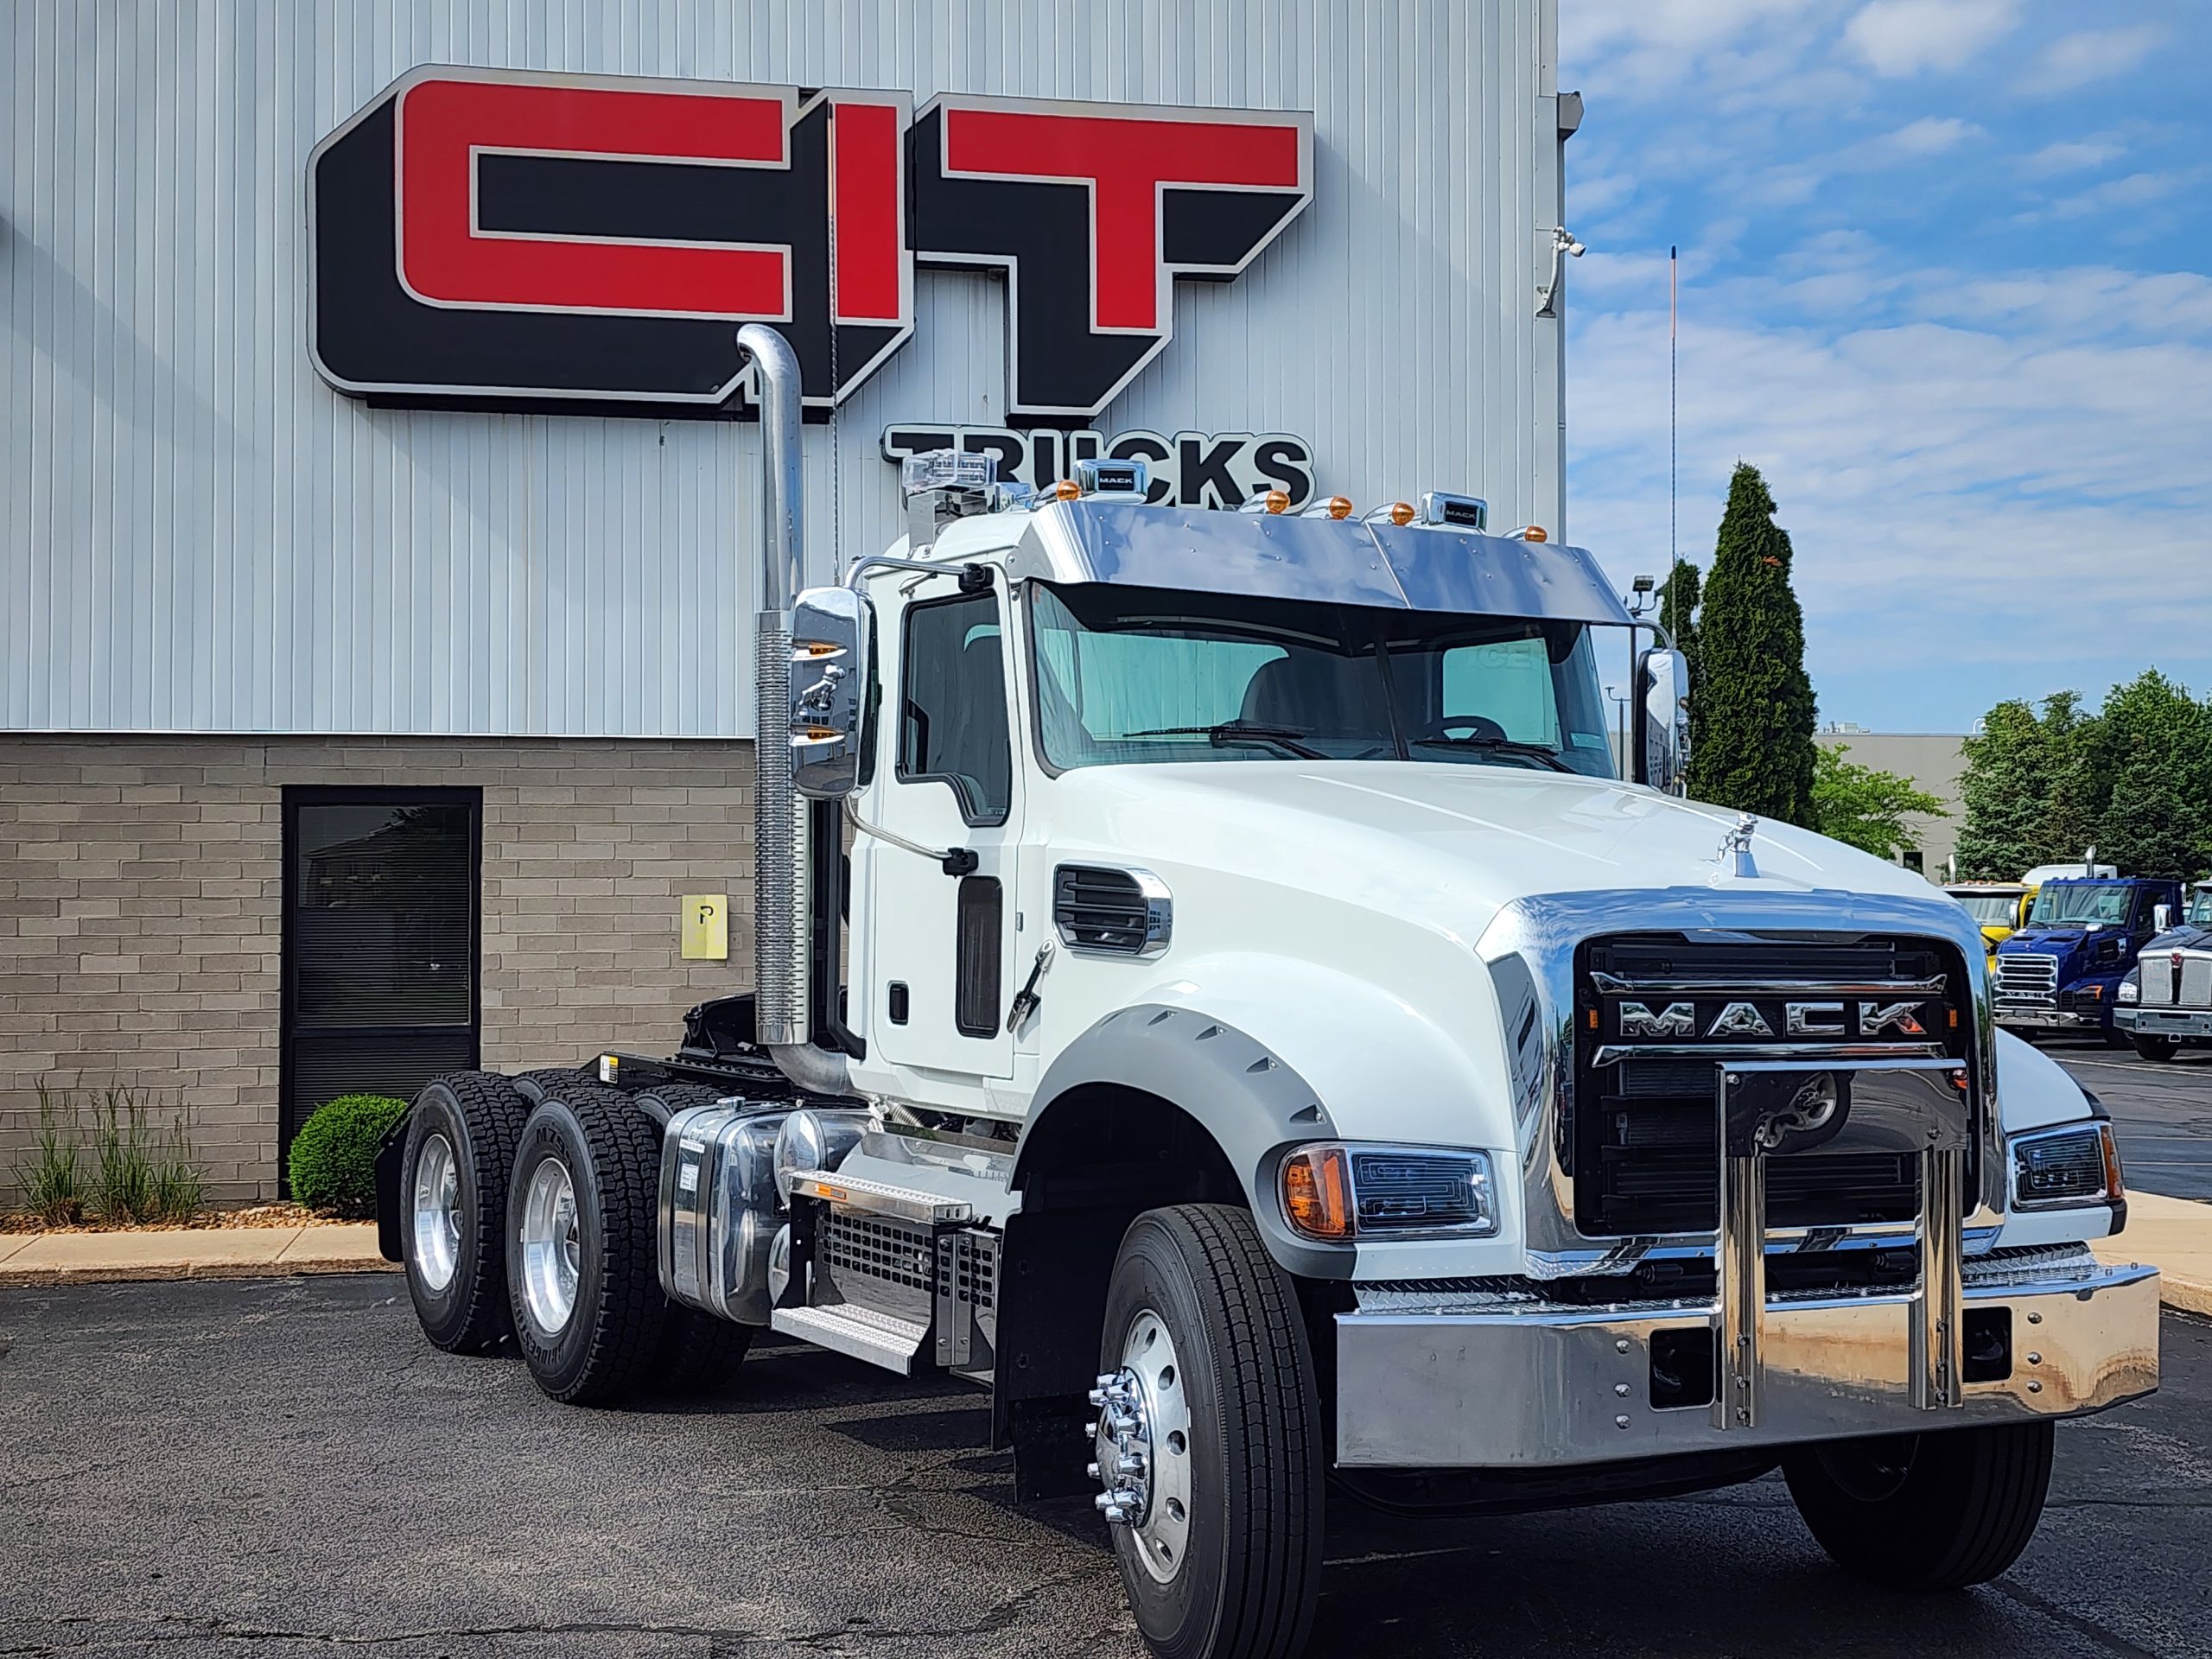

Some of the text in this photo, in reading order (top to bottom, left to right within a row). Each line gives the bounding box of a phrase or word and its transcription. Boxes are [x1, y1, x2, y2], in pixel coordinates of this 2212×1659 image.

[394, 73, 1306, 337] CIT
[1446, 509, 1476, 519] MACK
[1618, 1001, 1929, 1037] MACK
